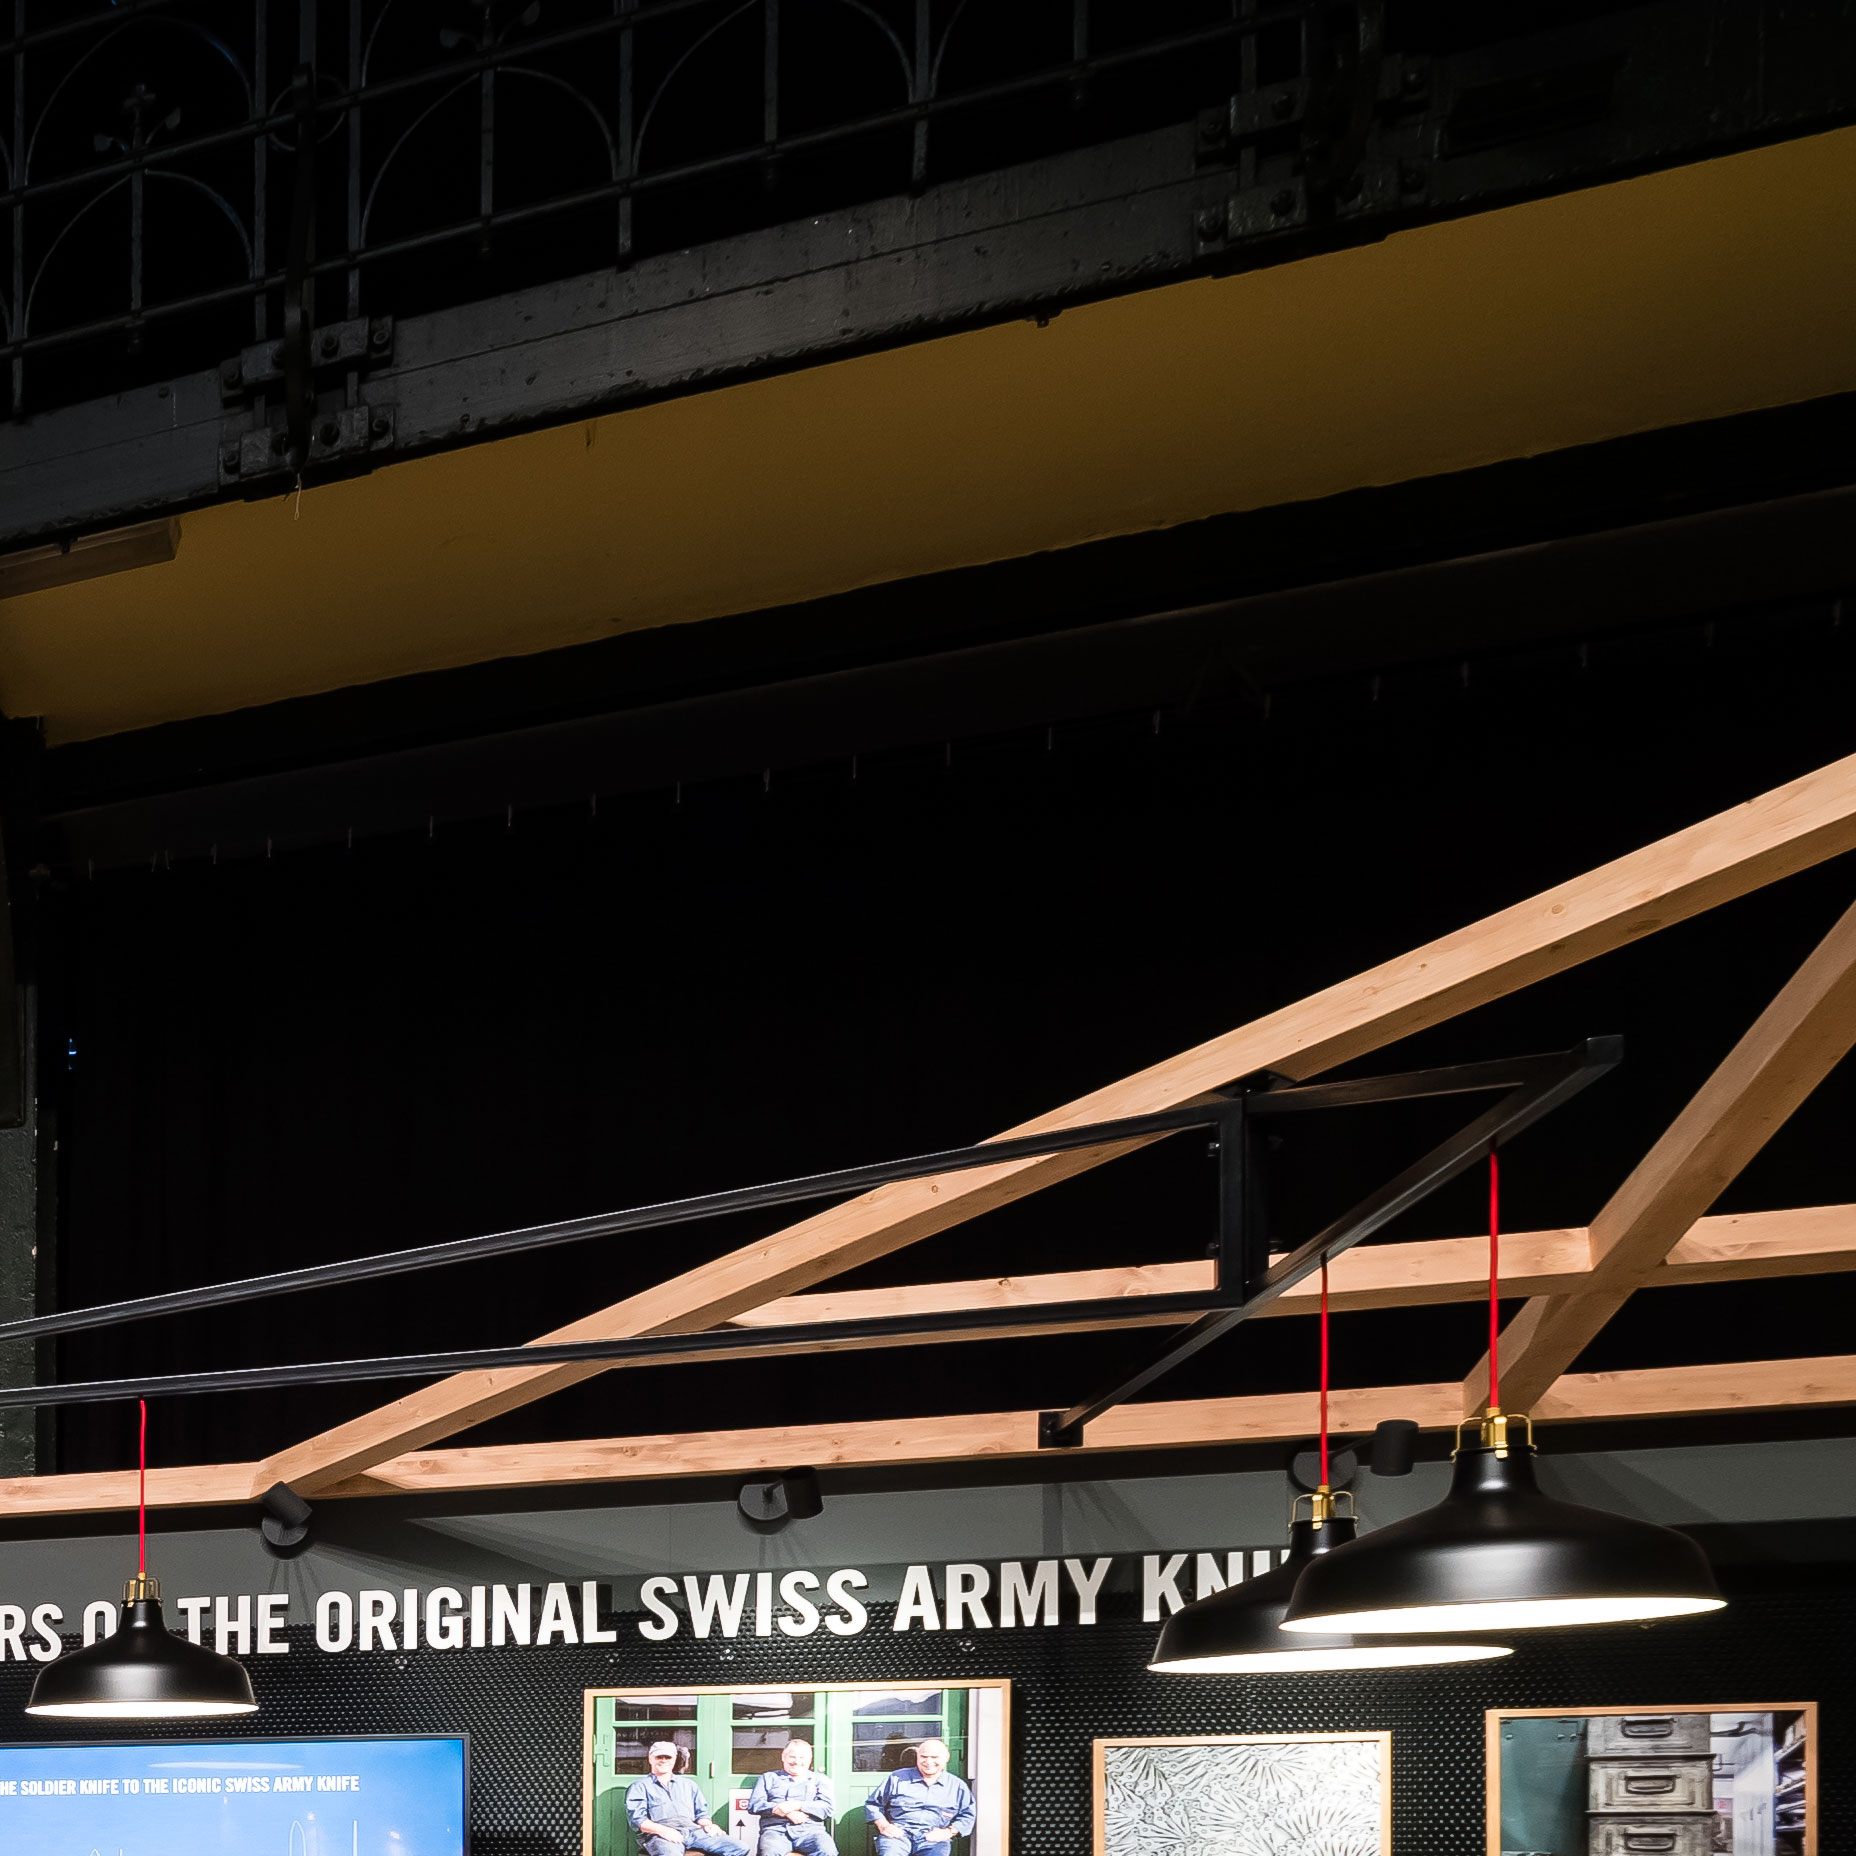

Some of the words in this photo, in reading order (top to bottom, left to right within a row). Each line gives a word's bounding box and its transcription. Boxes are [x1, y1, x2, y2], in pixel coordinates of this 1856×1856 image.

[177, 1593, 290, 1656] THE
[315, 1580, 618, 1654] ORIGINAL
[638, 1568, 870, 1641] SWISS
[892, 1557, 1113, 1632] ARMY
[20, 1780, 77, 1796] SOLDIER
[79, 1779, 120, 1795] KNIFE
[122, 1778, 140, 1794] TO
[143, 1778, 169, 1794] THE
[173, 1777, 222, 1794] ICONIC
[224, 1776, 271, 1793] SWISS
[273, 1776, 314, 1793] ARMY
[317, 1775, 360, 1792] KNIFE
